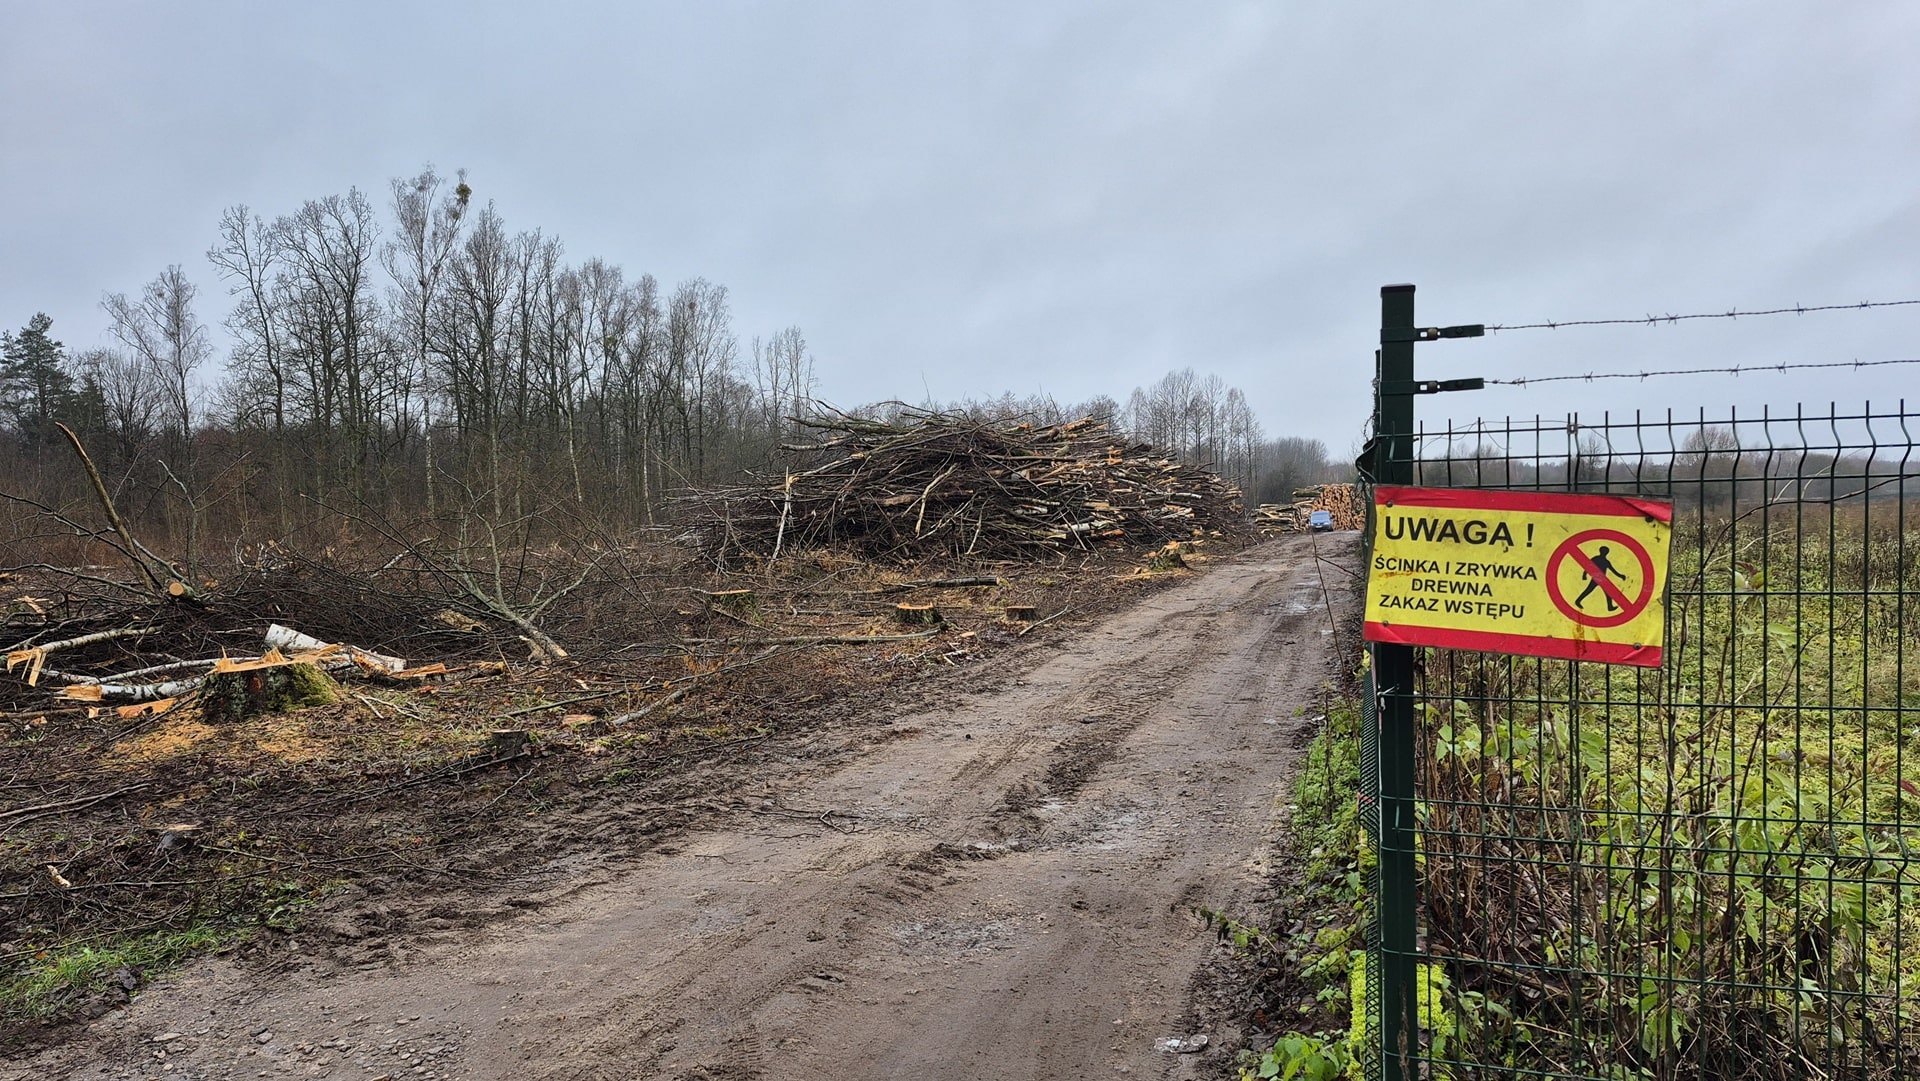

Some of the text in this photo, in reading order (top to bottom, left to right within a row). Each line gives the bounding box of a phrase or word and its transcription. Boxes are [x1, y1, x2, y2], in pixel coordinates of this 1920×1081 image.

[1526, 523, 1534, 548] !
[1374, 554, 1537, 580] ŚCINKA I ZRYWKA
[1411, 578, 1493, 597] DREWNA
[1379, 594, 1525, 619] ZAKAZ WSTĘPU
